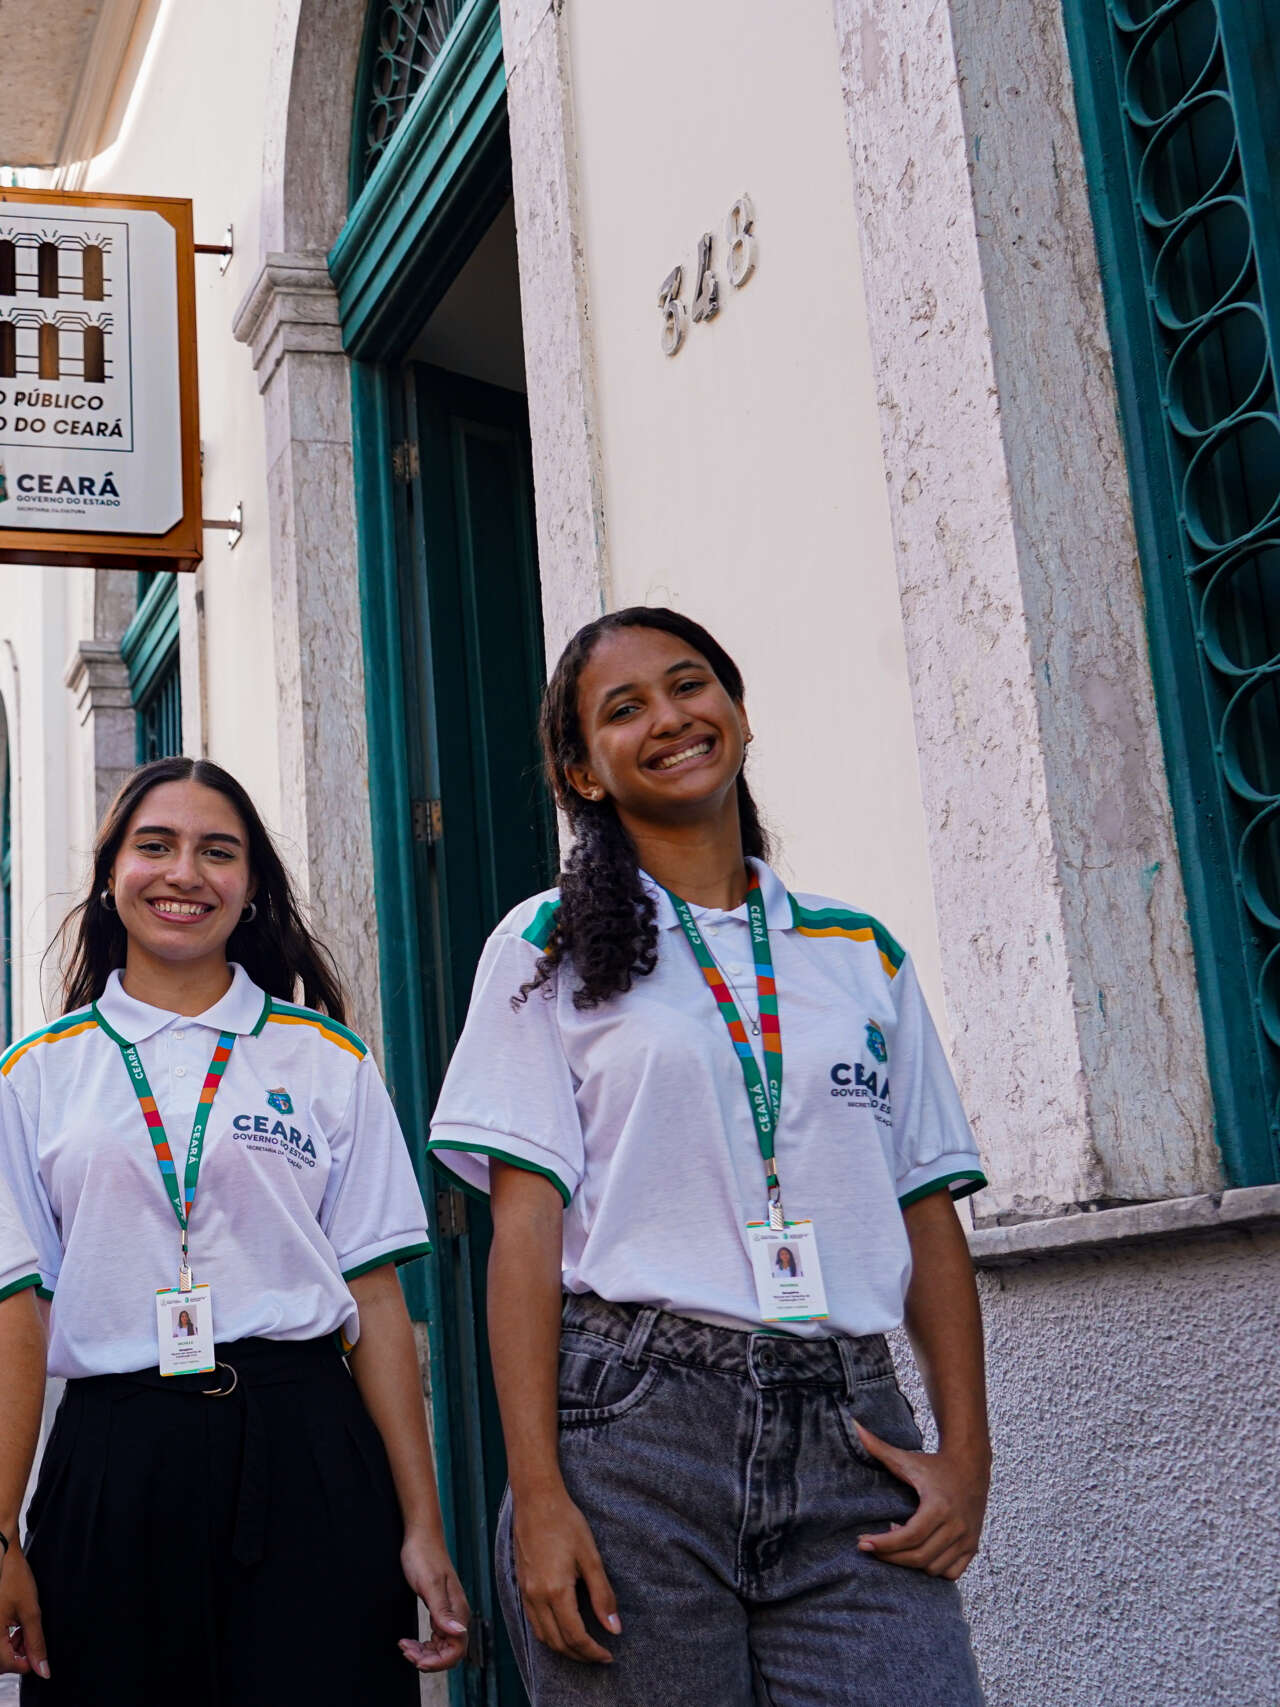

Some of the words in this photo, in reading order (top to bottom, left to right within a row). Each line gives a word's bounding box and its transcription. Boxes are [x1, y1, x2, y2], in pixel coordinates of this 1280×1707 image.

[13, 389, 103, 410] PÚBLICO
[14, 418, 46, 433] DO
[53, 419, 123, 438] CEARÁ
[16, 471, 120, 498] CEARÁ
[16, 495, 64, 504] GOVERNO
[66, 497, 81, 505] DO
[83, 498, 121, 507] ESTADO
[676, 905, 701, 944] CEARÁ
[750, 905, 768, 943] CEARÁ
[123, 1046, 143, 1080] CEARÁ
[749, 1083, 771, 1132] CEARÁ
[831, 1089, 869, 1097] GOVER
[188, 1124, 202, 1164] CEARÁ
[233, 1114, 317, 1159] CEARÁ
[233, 1133, 278, 1144] GOVERNO
[289, 1146, 315, 1168] ESTADO
